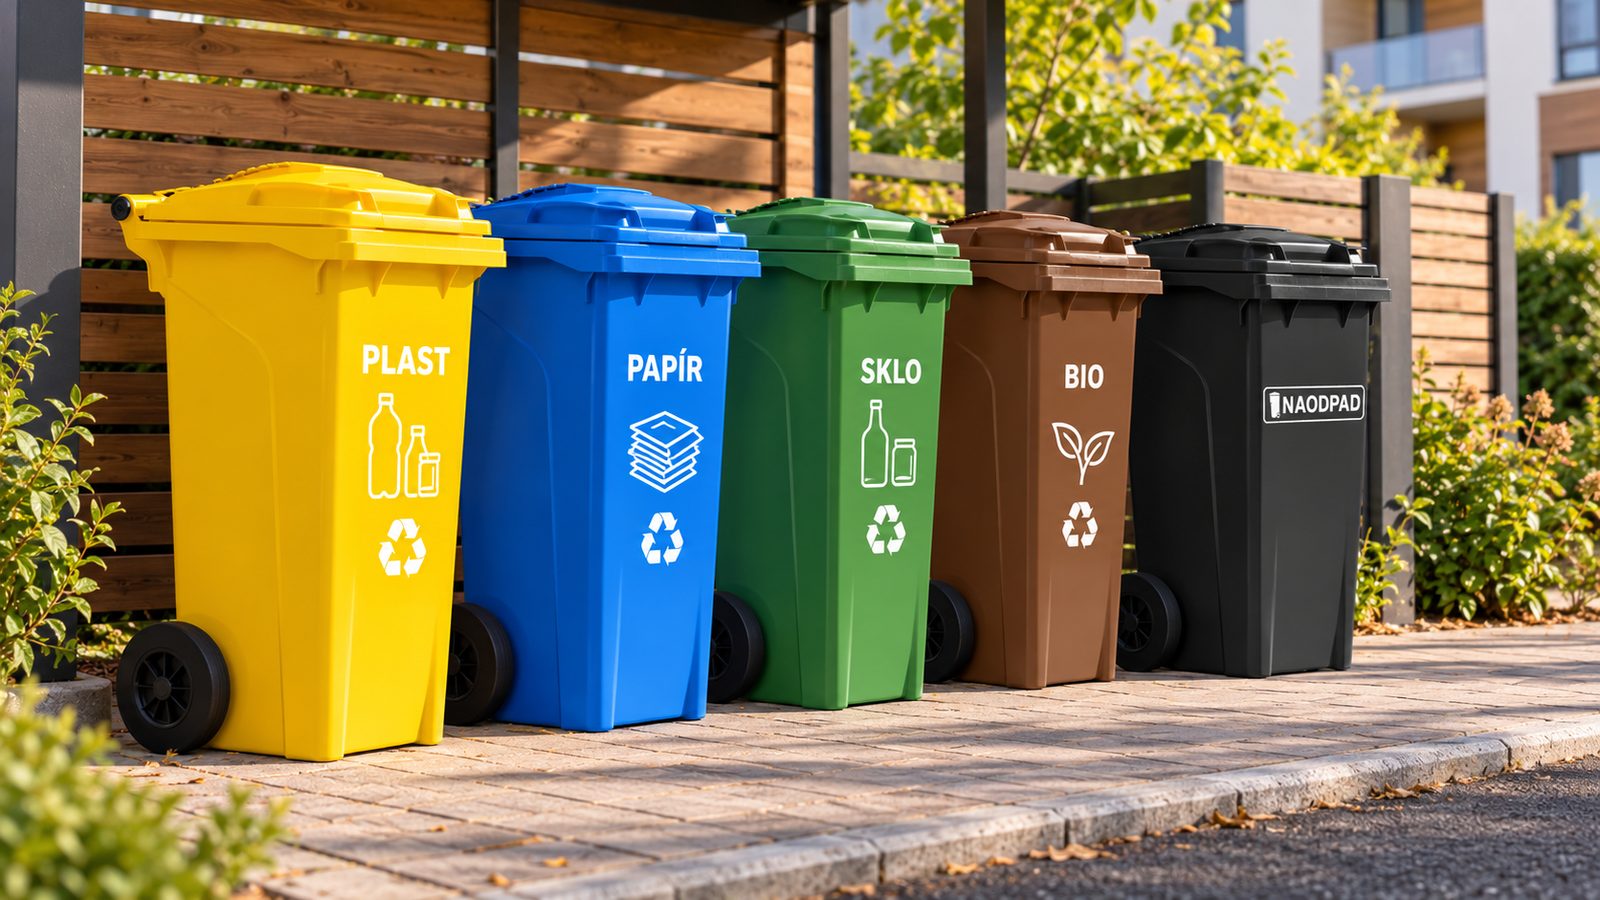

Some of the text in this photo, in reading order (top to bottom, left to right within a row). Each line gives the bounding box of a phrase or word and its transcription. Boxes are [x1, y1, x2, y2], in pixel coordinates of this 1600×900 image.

[362, 345, 450, 376] PLAST
[627, 348, 703, 382] PAPÍR
[860, 357, 922, 385] SKLO
[1064, 363, 1105, 389] BIO
[1282, 394, 1361, 414] NAODPAD
